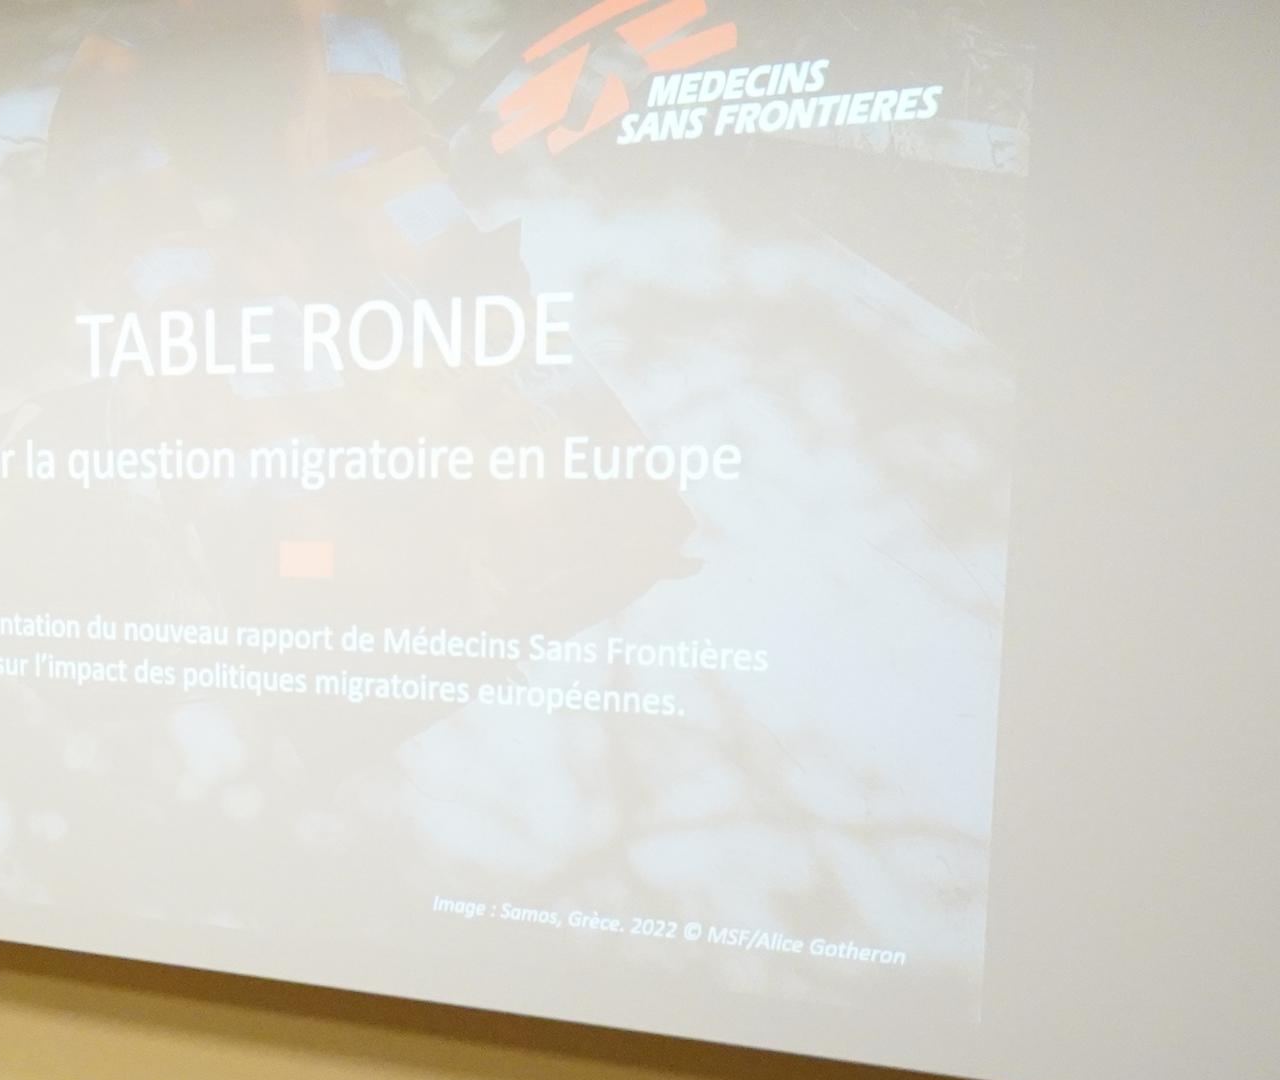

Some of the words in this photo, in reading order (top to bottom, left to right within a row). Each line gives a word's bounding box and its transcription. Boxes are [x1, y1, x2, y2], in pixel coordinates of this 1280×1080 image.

[647, 59, 830, 107] MEDECINS
[616, 107, 707, 145] SANS
[714, 85, 943, 136] FRONTIERES
[75, 306, 276, 379] TABLE
[303, 291, 575, 372] RONDE
[26, 438, 55, 480] la
[68, 439, 235, 489] question
[249, 437, 474, 490] migratoire
[489, 444, 545, 480] en
[564, 435, 742, 492] Europe
[87, 614, 117, 641] du
[124, 620, 228, 646] nouveau
[237, 623, 333, 655] rapport
[341, 627, 375, 653] de
[383, 625, 520, 660] Médecins
[529, 634, 597, 664] Sans
[607, 636, 768, 673] Frontières
[134, 658, 175, 686] des
[183, 661, 307, 696] politiques
[315, 669, 469, 704] migratoires
[478, 679, 685, 717] européennes.
[433, 896, 486, 919] Image
[500, 903, 561, 928] Samos,
[568, 910, 624, 932] Grèce.
[630, 917, 678, 938] 2022
[683, 921, 702, 941] ©
[707, 926, 804, 953] MSF/Alice
[809, 938, 907, 965] Gotheron
